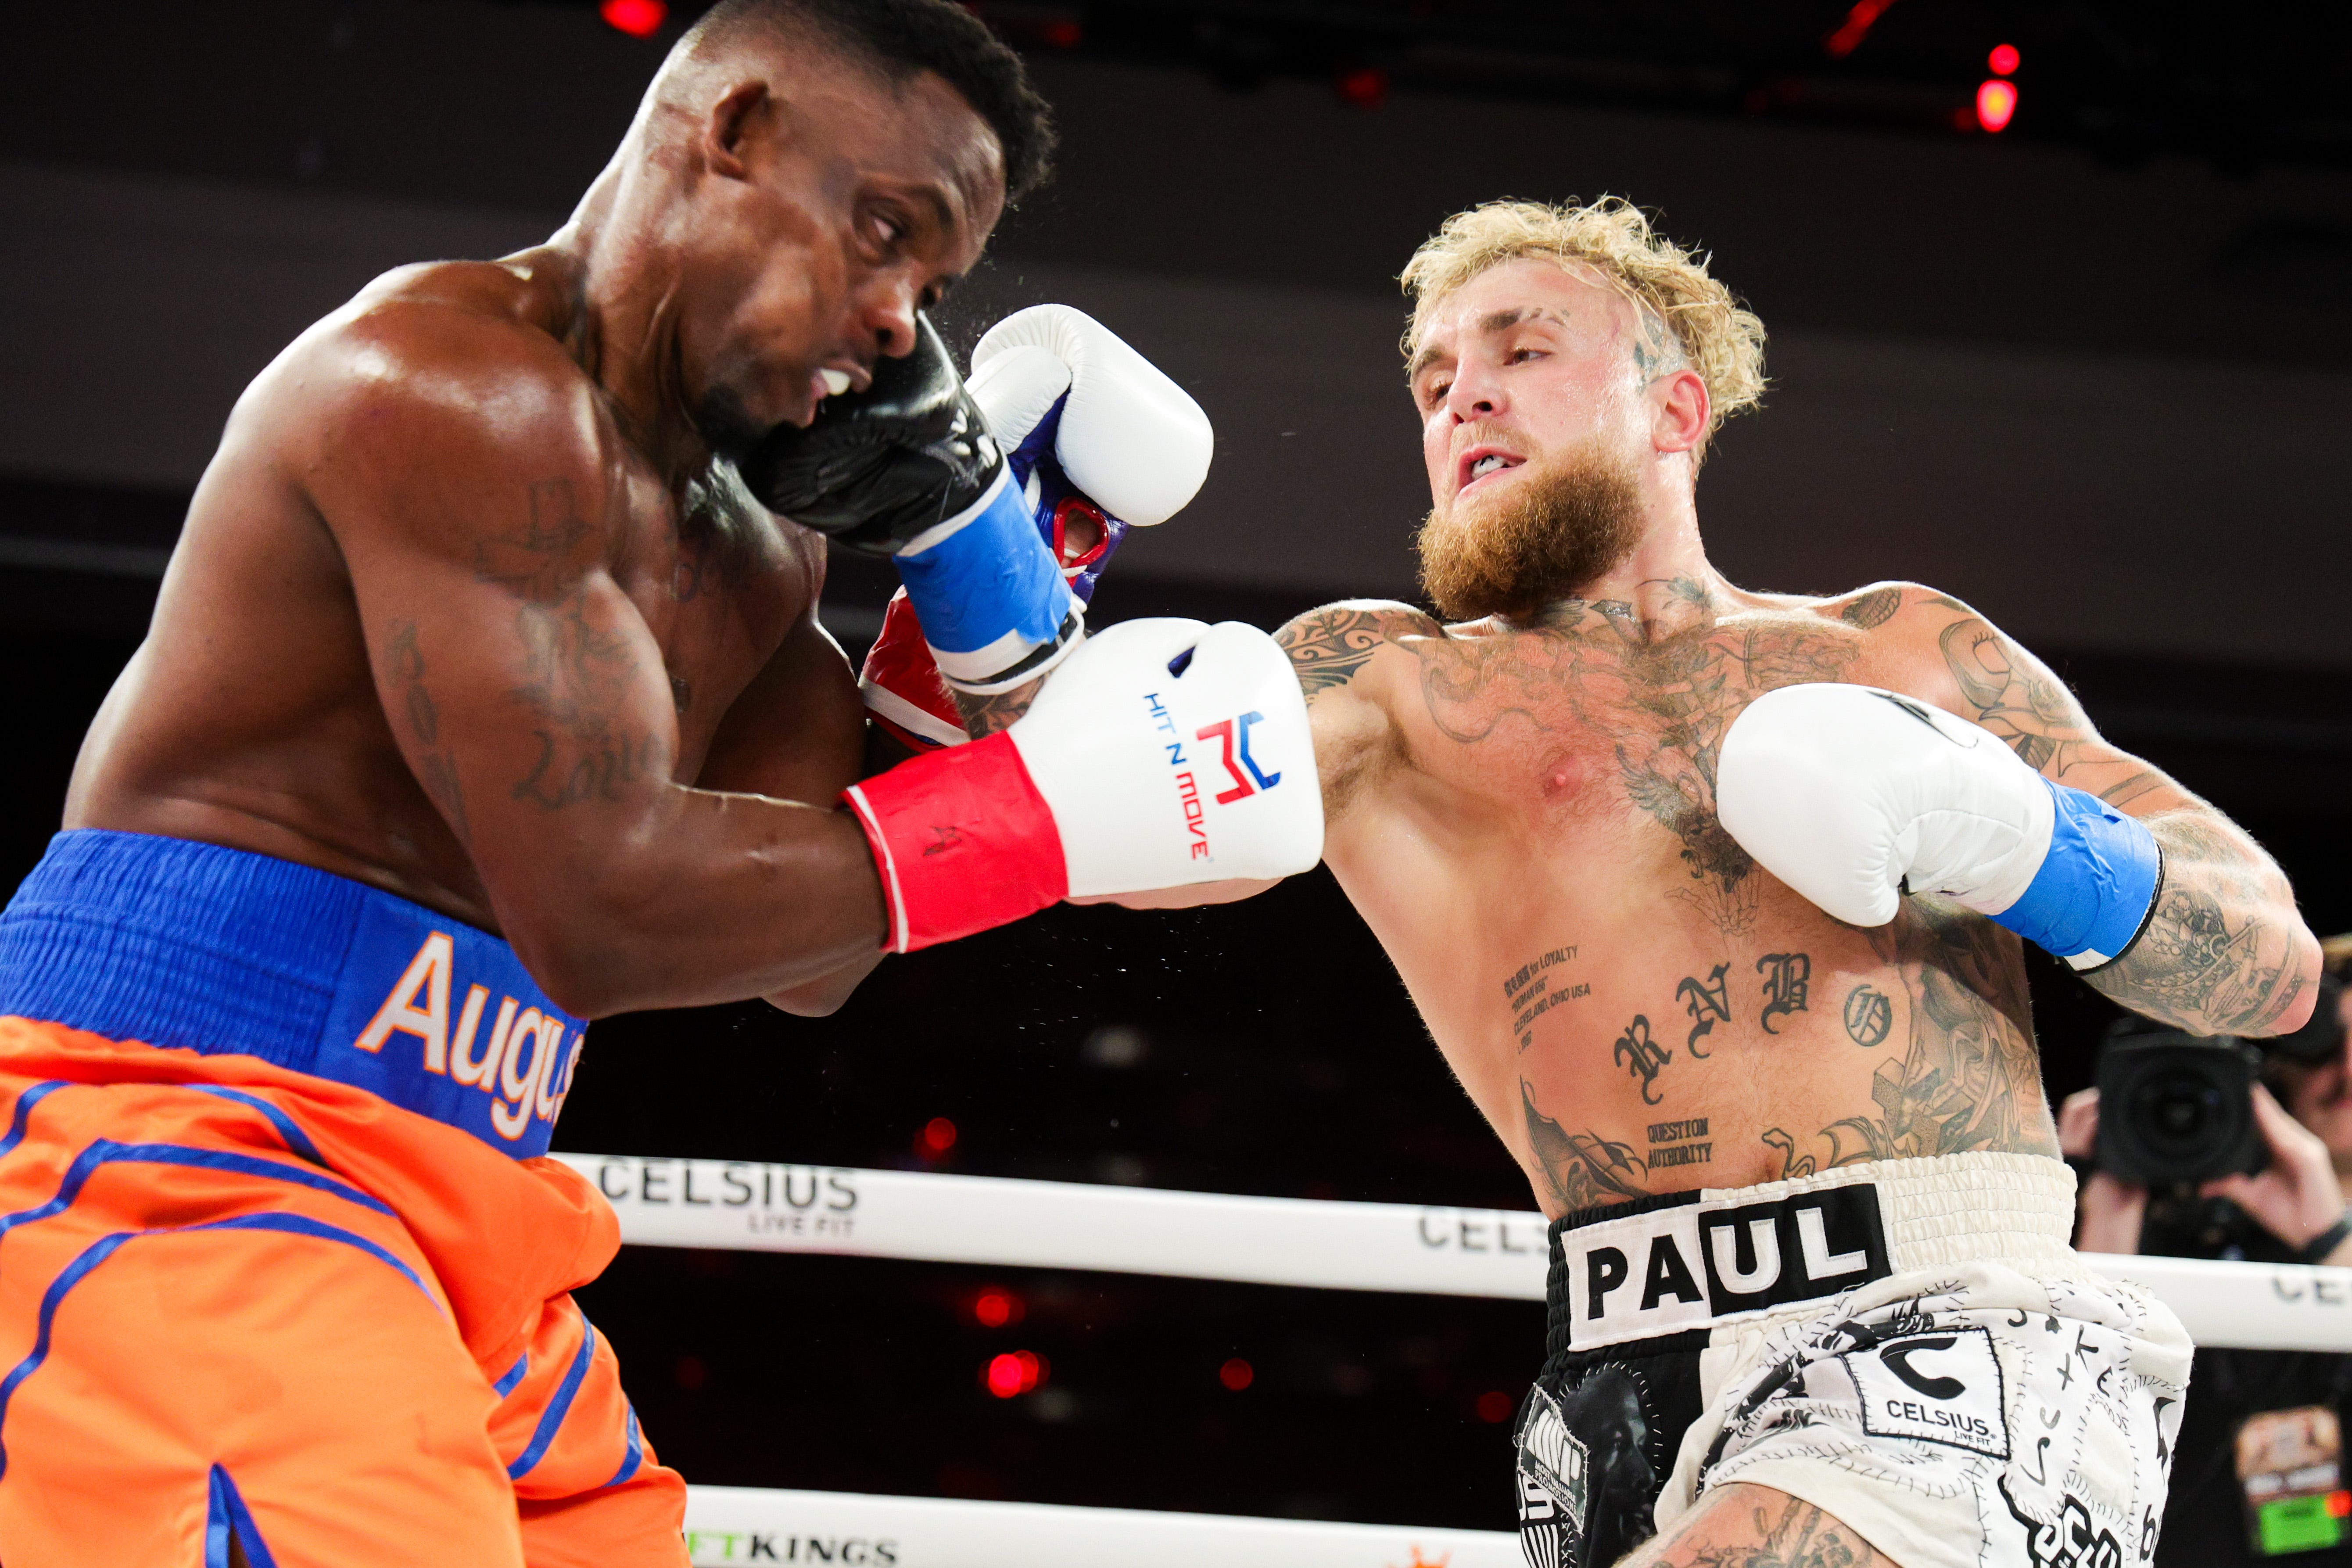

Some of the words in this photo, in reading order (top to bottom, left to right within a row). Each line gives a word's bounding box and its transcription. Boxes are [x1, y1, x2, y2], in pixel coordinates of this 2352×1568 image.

[1144, 693, 1176, 733] HIT
[1540, 945, 1578, 969] LOYALTY
[1550, 988, 1569, 1007] OHIO
[1571, 983, 1591, 999] USA
[1647, 1117, 1708, 1144] QUESTION
[1648, 1142, 1713, 1169] AUTHORITY
[599, 1160, 857, 1211] CELSIUS
[1586, 1207, 1868, 1320] PAUL
[1886, 1400, 1989, 1436] CELSIUS
[1954, 1431, 1975, 1443] LIVE
[1976, 1436, 1990, 1446] FIT
[1535, 1460, 1551, 1480] MOST
[1550, 1474, 1576, 1505] VALUABLE
[1535, 1469, 1577, 1515] PROMOTIONS
